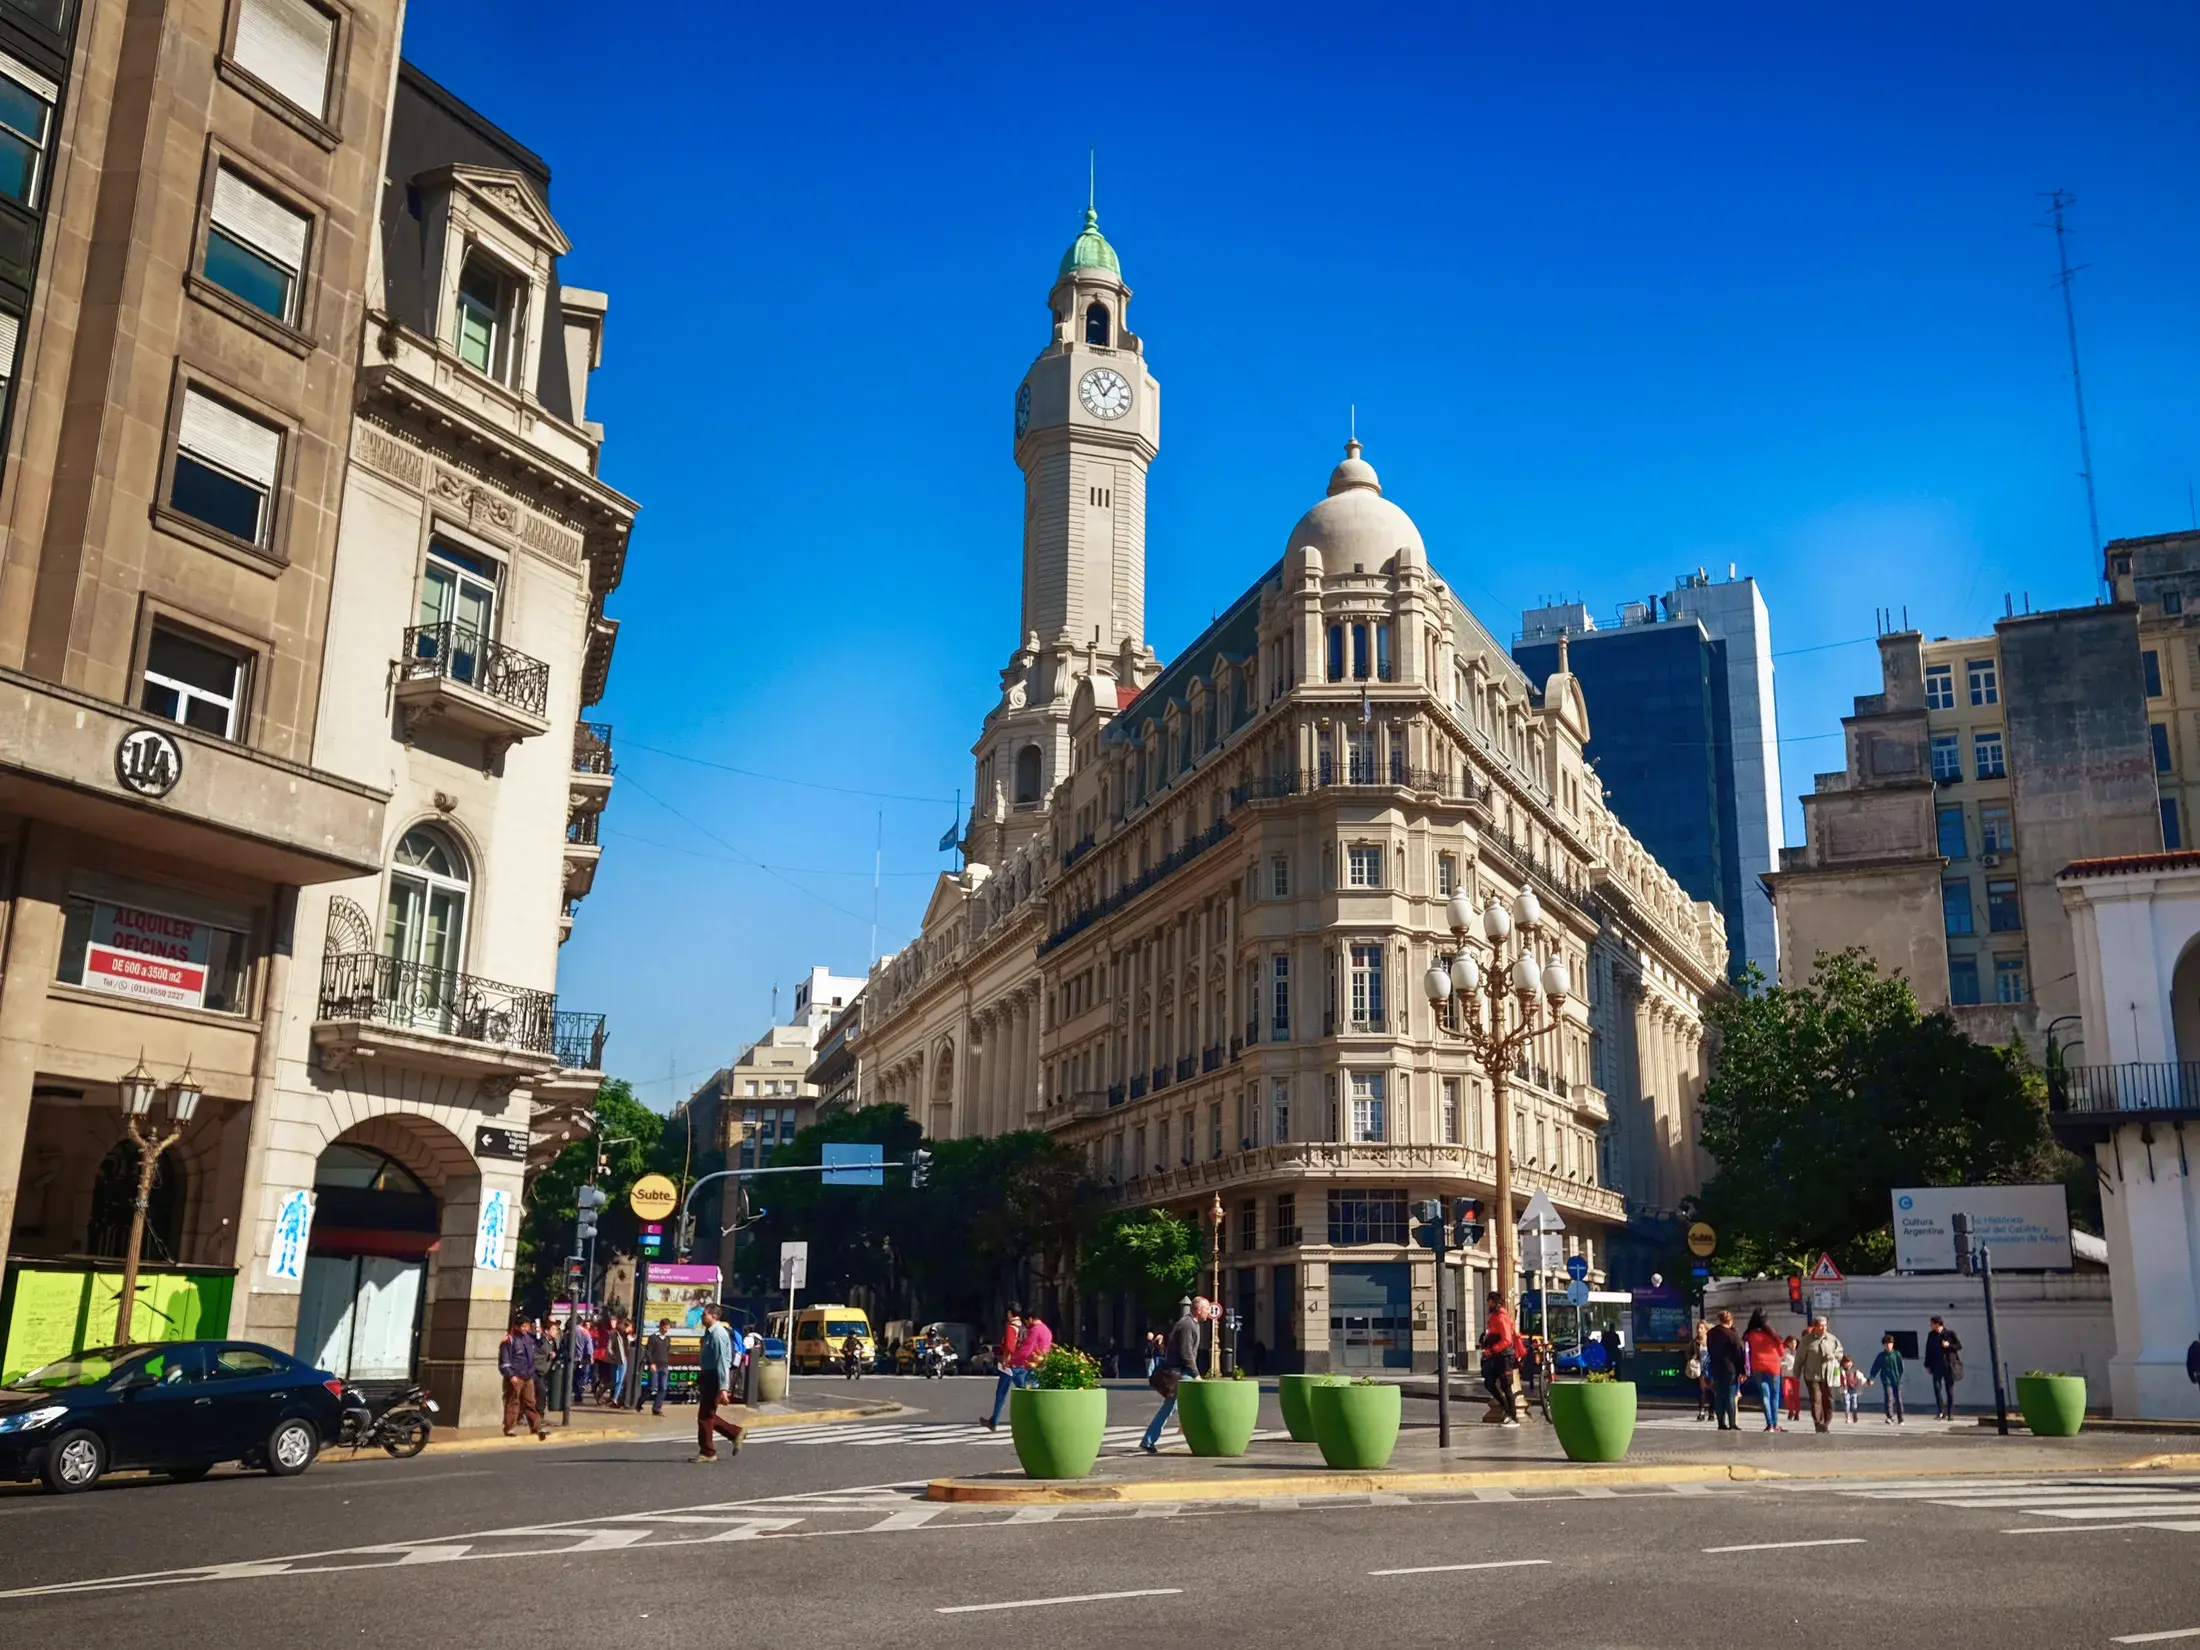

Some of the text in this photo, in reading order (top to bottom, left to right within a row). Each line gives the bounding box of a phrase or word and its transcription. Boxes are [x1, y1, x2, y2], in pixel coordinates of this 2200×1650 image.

[113, 907, 195, 941] ALQUILER
[112, 931, 189, 962] OFICINAS
[112, 958, 183, 984] DE 600 a 3500 m2
[637, 1188, 671, 1201] Subte
[1902, 1218, 1934, 1226] Cultura
[647, 1225, 654, 1234] E
[1903, 1228, 1945, 1237] Argentina
